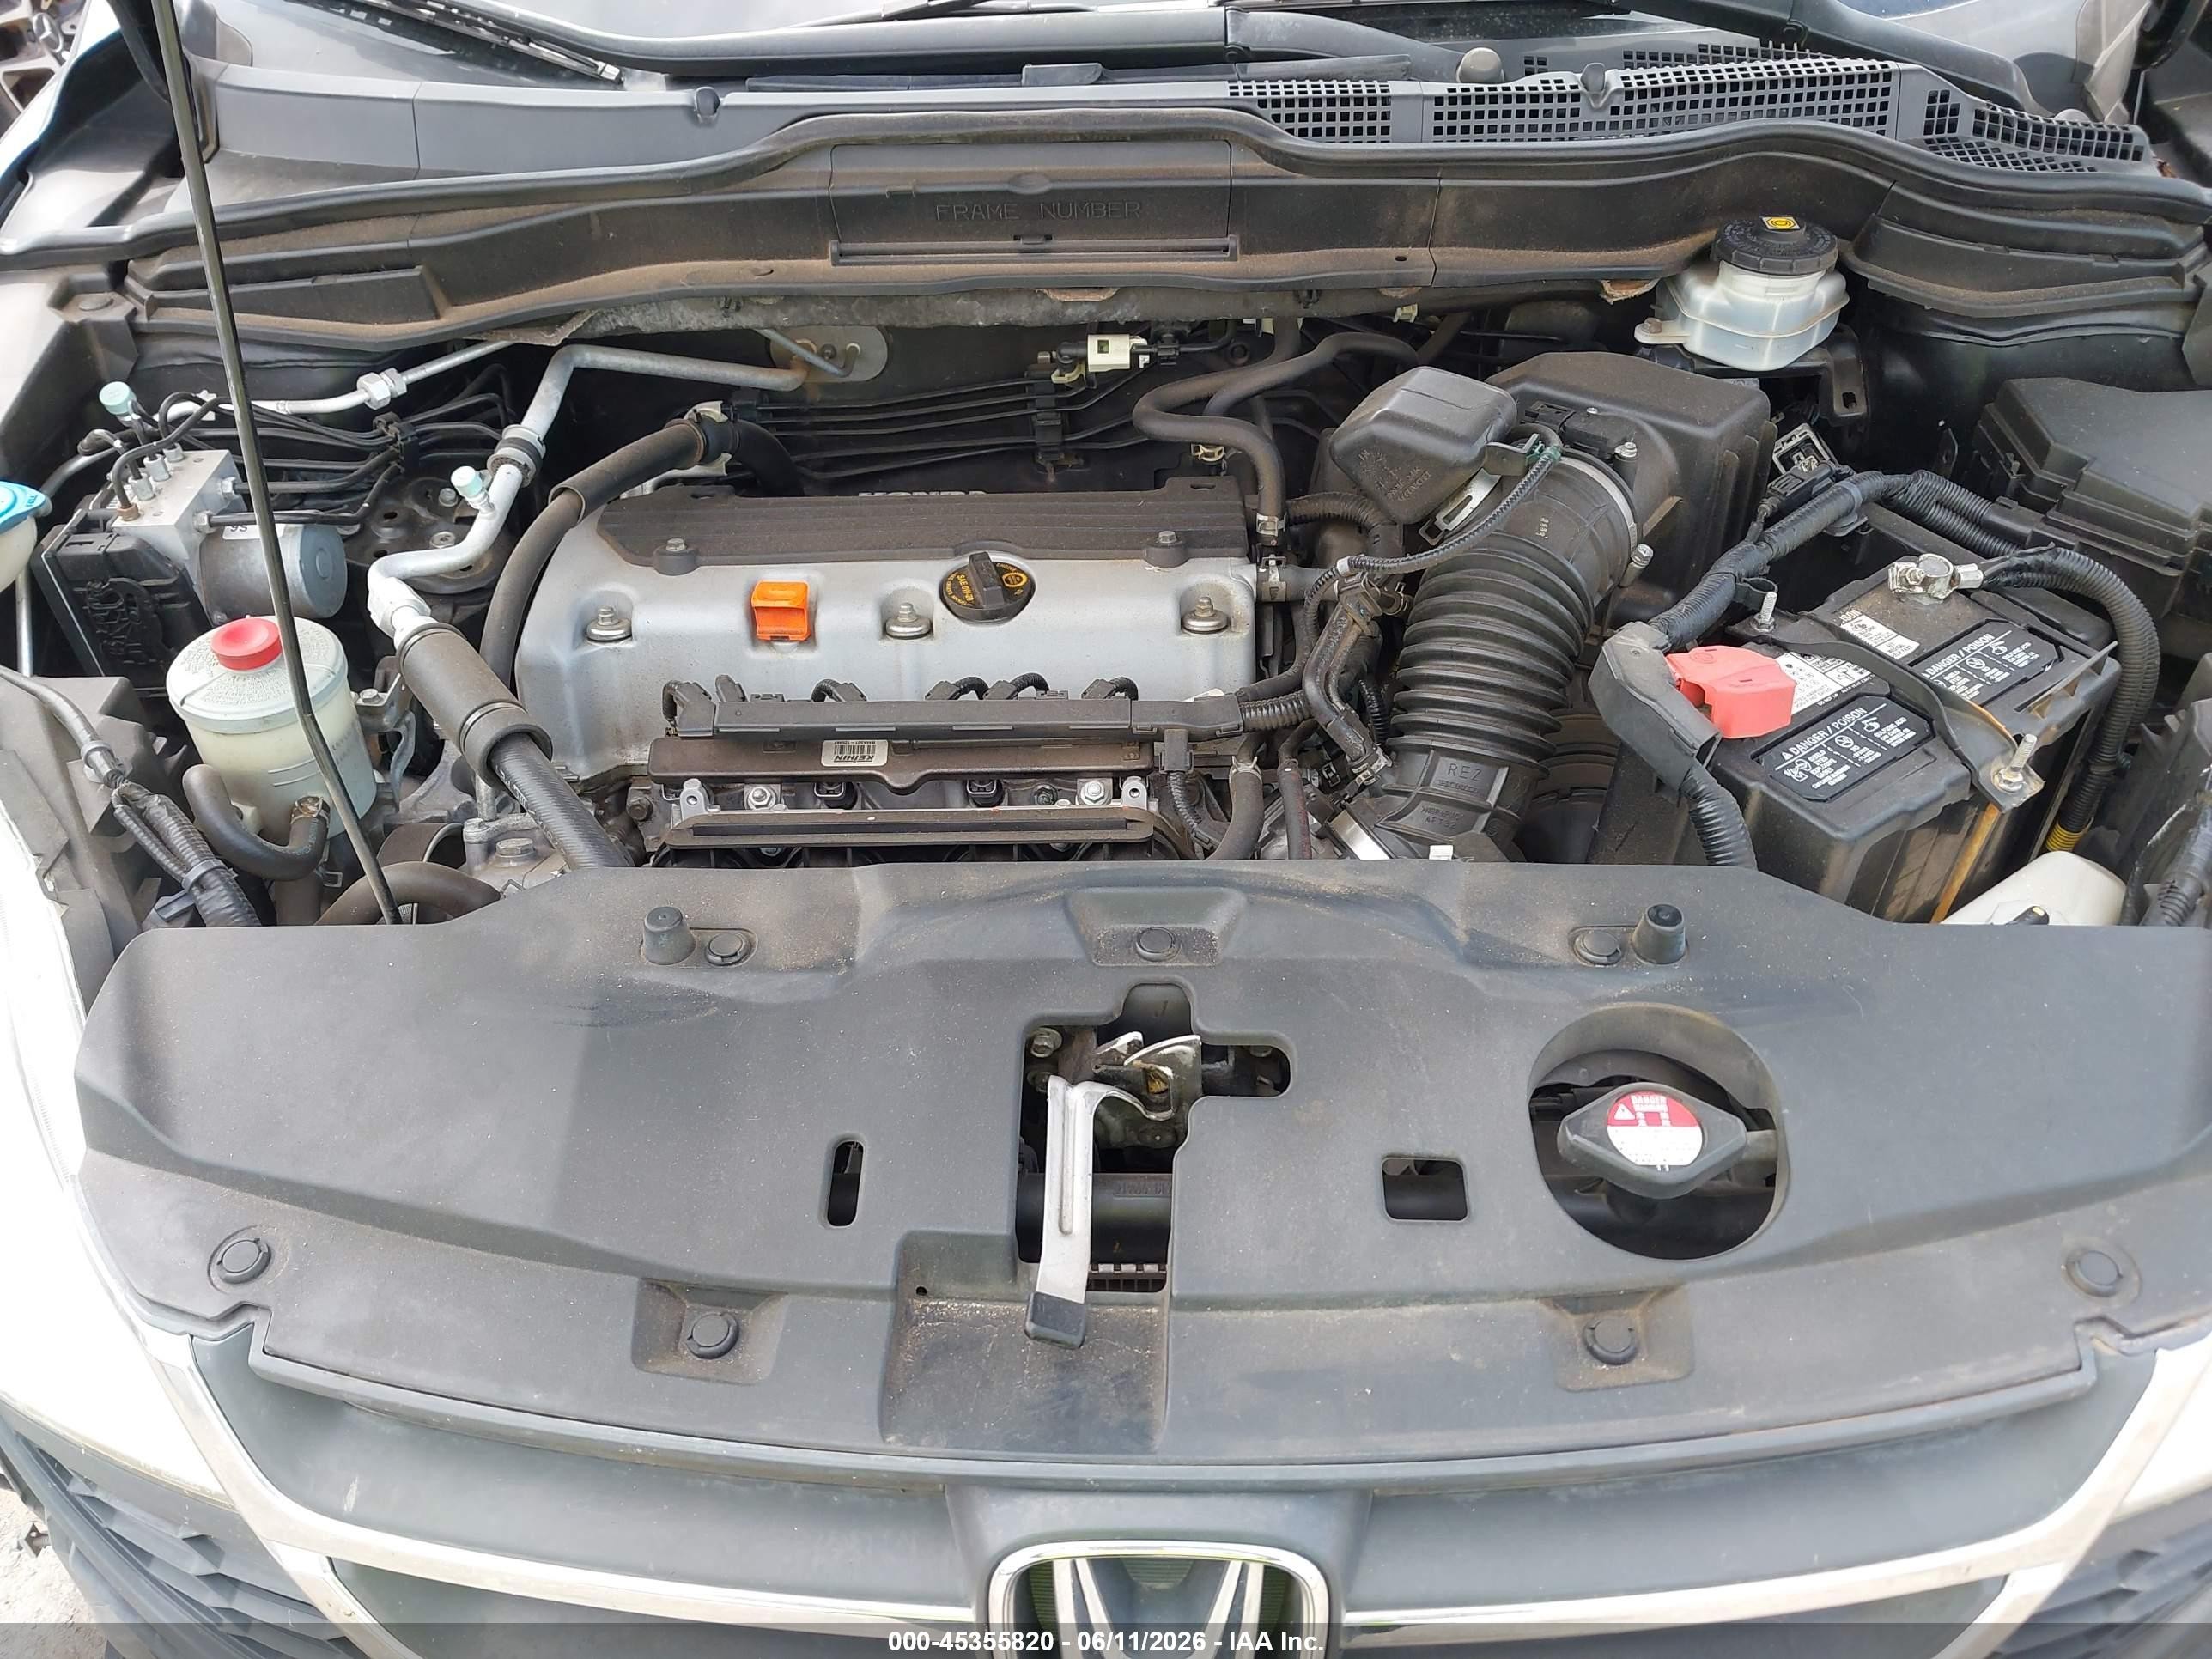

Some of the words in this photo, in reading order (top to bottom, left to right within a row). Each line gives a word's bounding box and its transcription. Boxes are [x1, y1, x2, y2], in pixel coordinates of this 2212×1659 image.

[936, 203, 1019, 220] FRAME
[1040, 201, 1141, 219] NUMBER
[957, 574, 969, 586] SAE
[1925, 653, 1961, 676] DANGER
[1962, 633, 1996, 653] POISON
[1789, 730, 1829, 756] DANGER
[1833, 707, 1868, 730] POISON
[834, 755, 874, 763] KEIHIN
[1448, 763, 1482, 782] REZ
